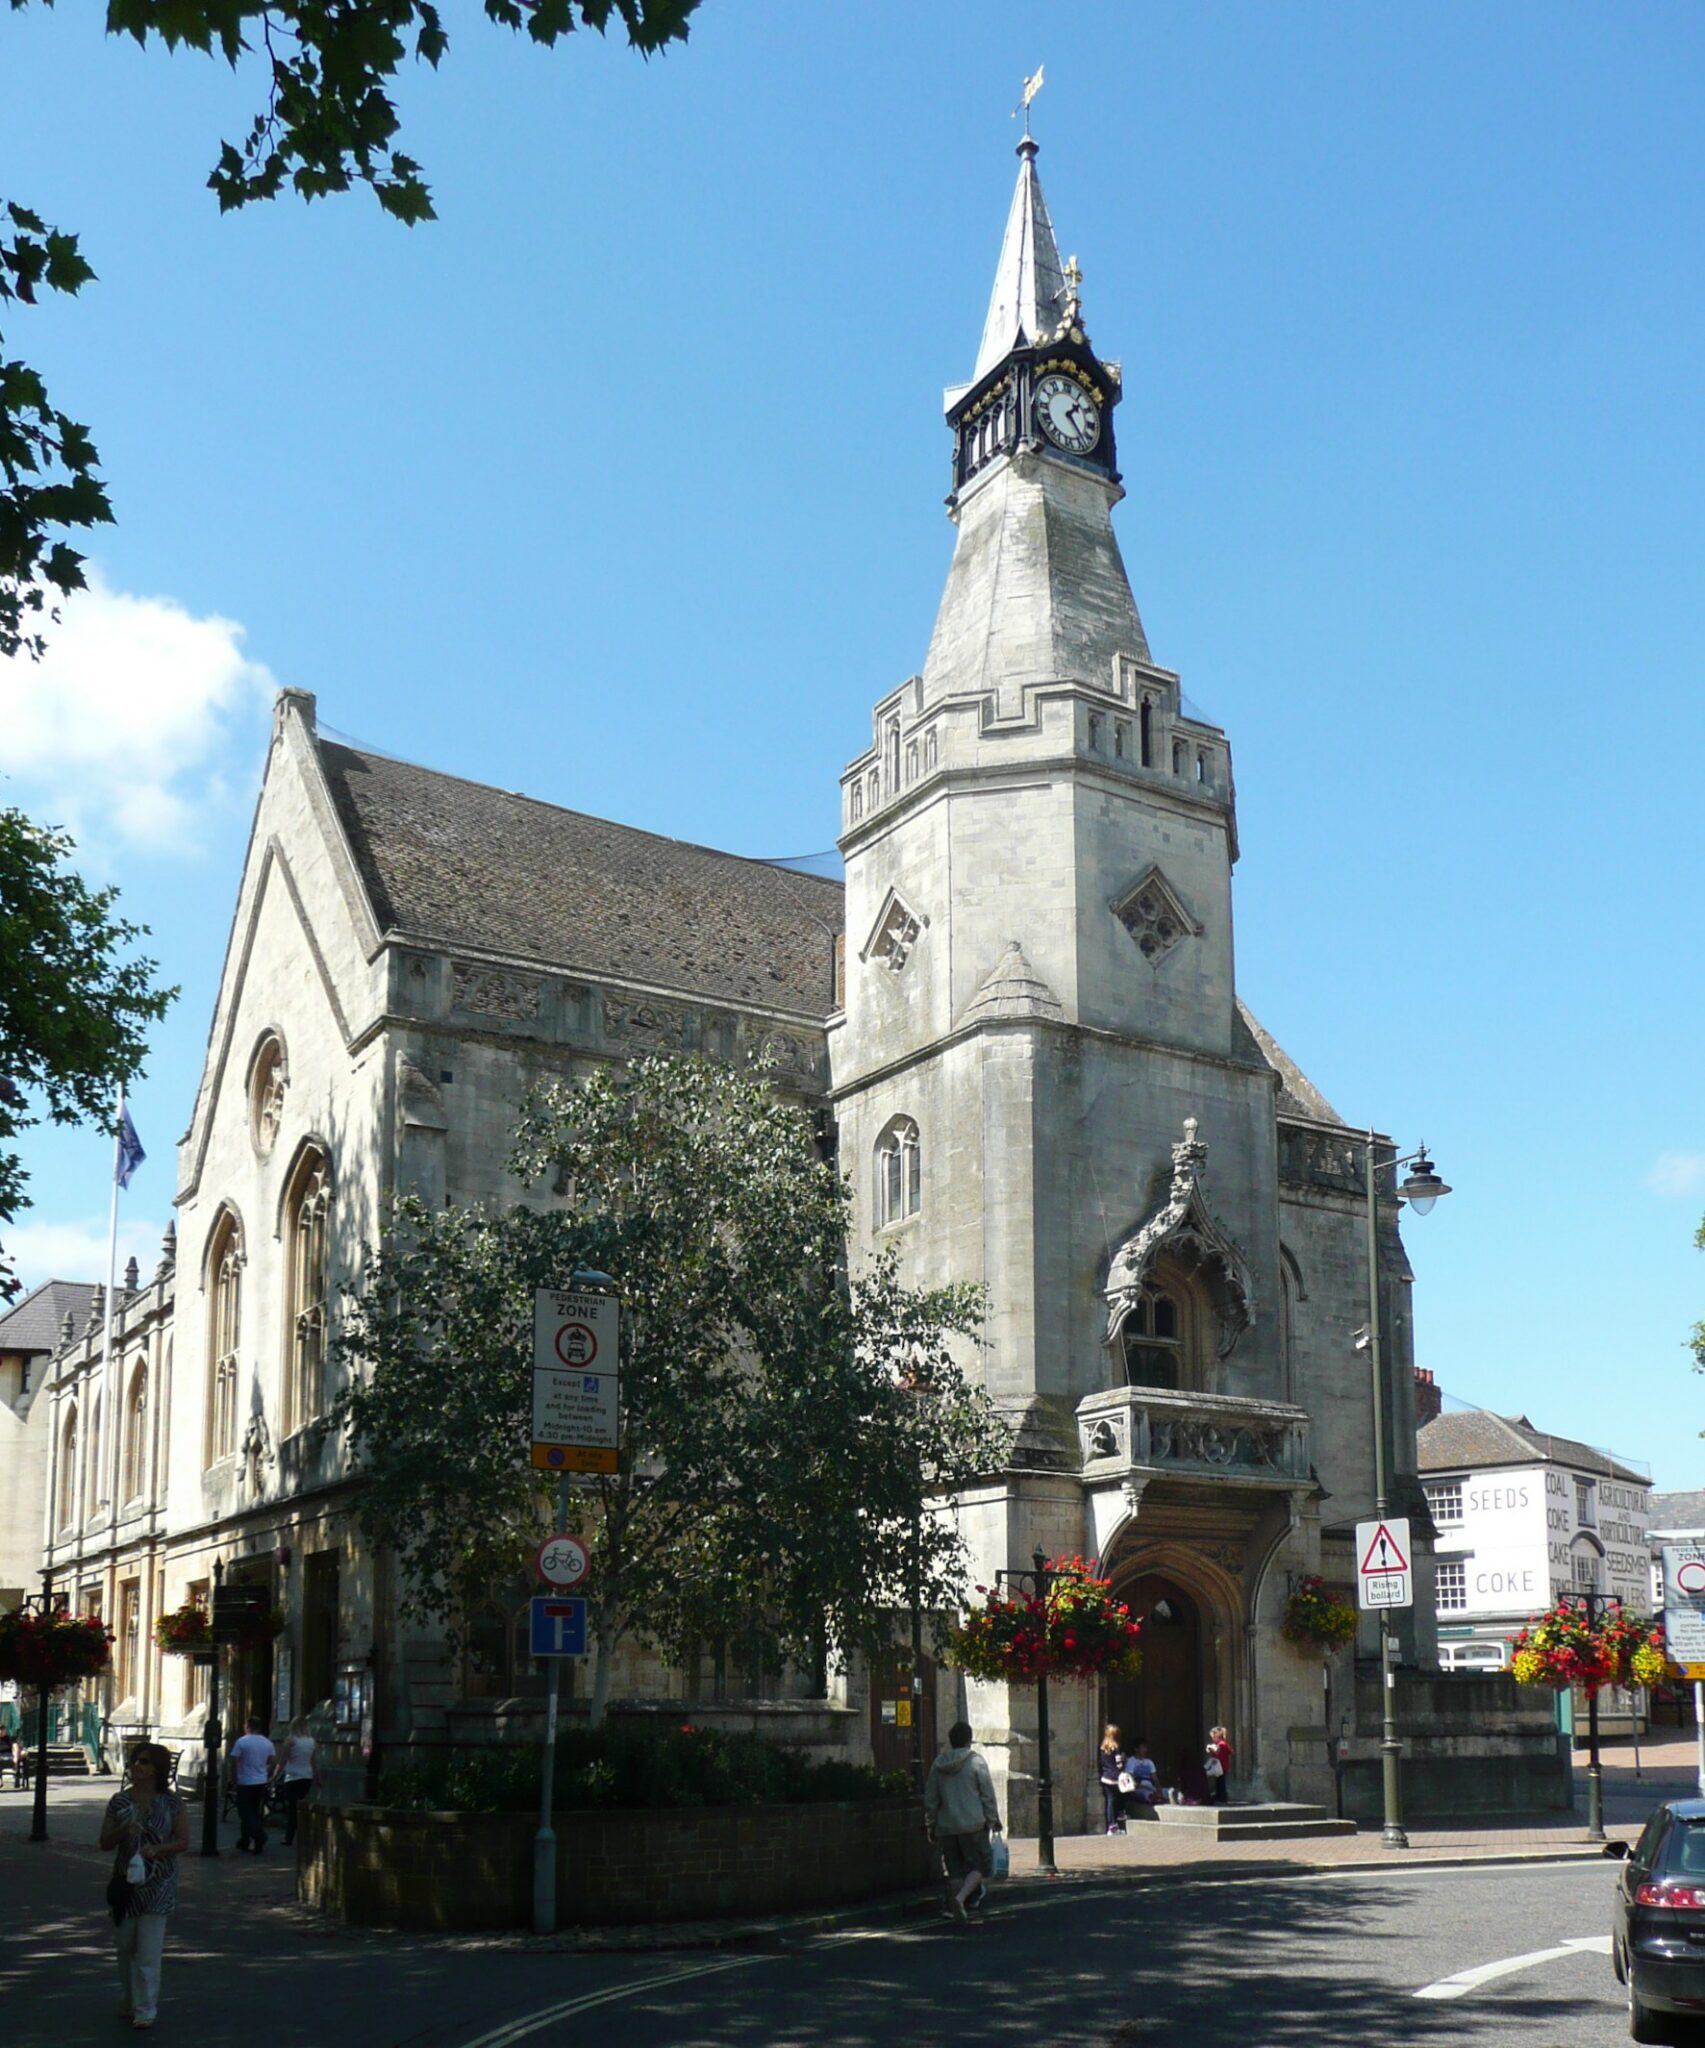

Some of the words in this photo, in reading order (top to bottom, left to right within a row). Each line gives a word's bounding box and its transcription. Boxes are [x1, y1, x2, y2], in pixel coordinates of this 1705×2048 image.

[550, 1293, 605, 1306] PEDESTRIAN
[557, 1304, 598, 1319] ZONE
[552, 1377, 580, 1388] Except
[581, 1395, 598, 1403] time
[558, 1412, 593, 1421] between
[563, 1403, 575, 1411] for
[577, 1404, 606, 1415] loading
[1545, 1472, 1568, 1498] COAL
[1470, 1487, 1529, 1511] SEEDS
[1599, 1481, 1649, 1514] AGRICULTURAL
[1547, 1508, 1569, 1532] COKE
[1618, 1512, 1631, 1523] AND
[1599, 1519, 1650, 1547] HORTICULTURAL
[1548, 1542, 1570, 1565] CAKE
[1606, 1550, 1651, 1576] SEEDSMEN
[1372, 1581, 1398, 1591] Rising
[1476, 1570, 1535, 1594] COKE
[1370, 1590, 1401, 1601] bollard
